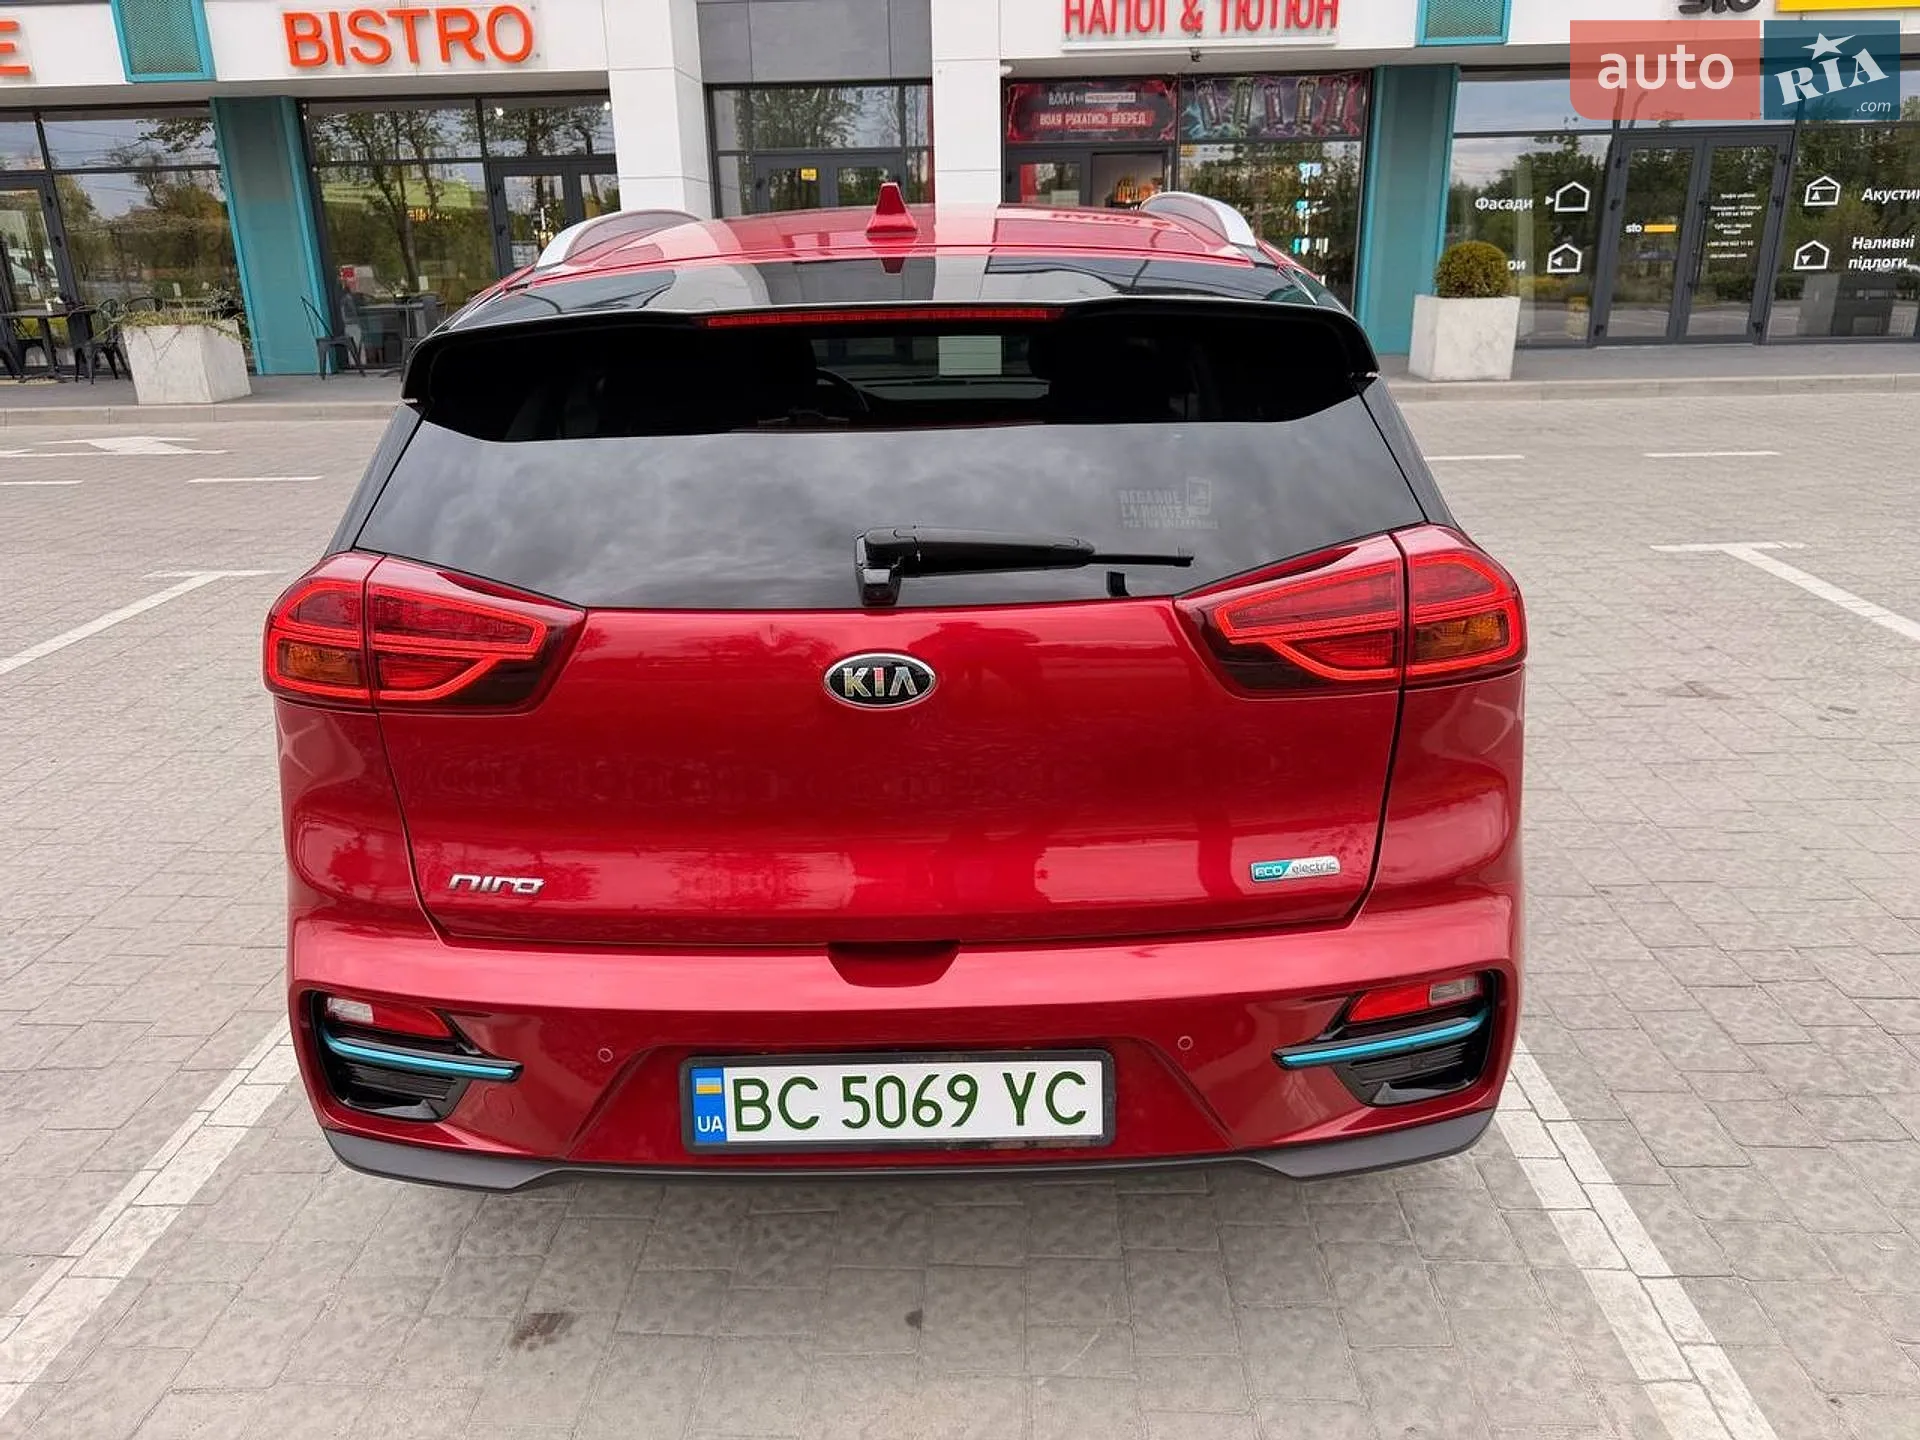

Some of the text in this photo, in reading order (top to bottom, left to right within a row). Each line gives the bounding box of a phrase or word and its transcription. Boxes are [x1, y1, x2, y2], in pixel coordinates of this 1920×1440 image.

[1180, 0, 1204, 32] &
[283, 5, 533, 67] BISTRO
[1475, 197, 1533, 212] Фасади
[1852, 235, 1915, 249] Наливні
[1848, 256, 1908, 271] підлоги
[842, 666, 918, 697] KIA
[733, 1071, 1087, 1132] BC 5069 YC
[697, 1115, 724, 1133] UA
